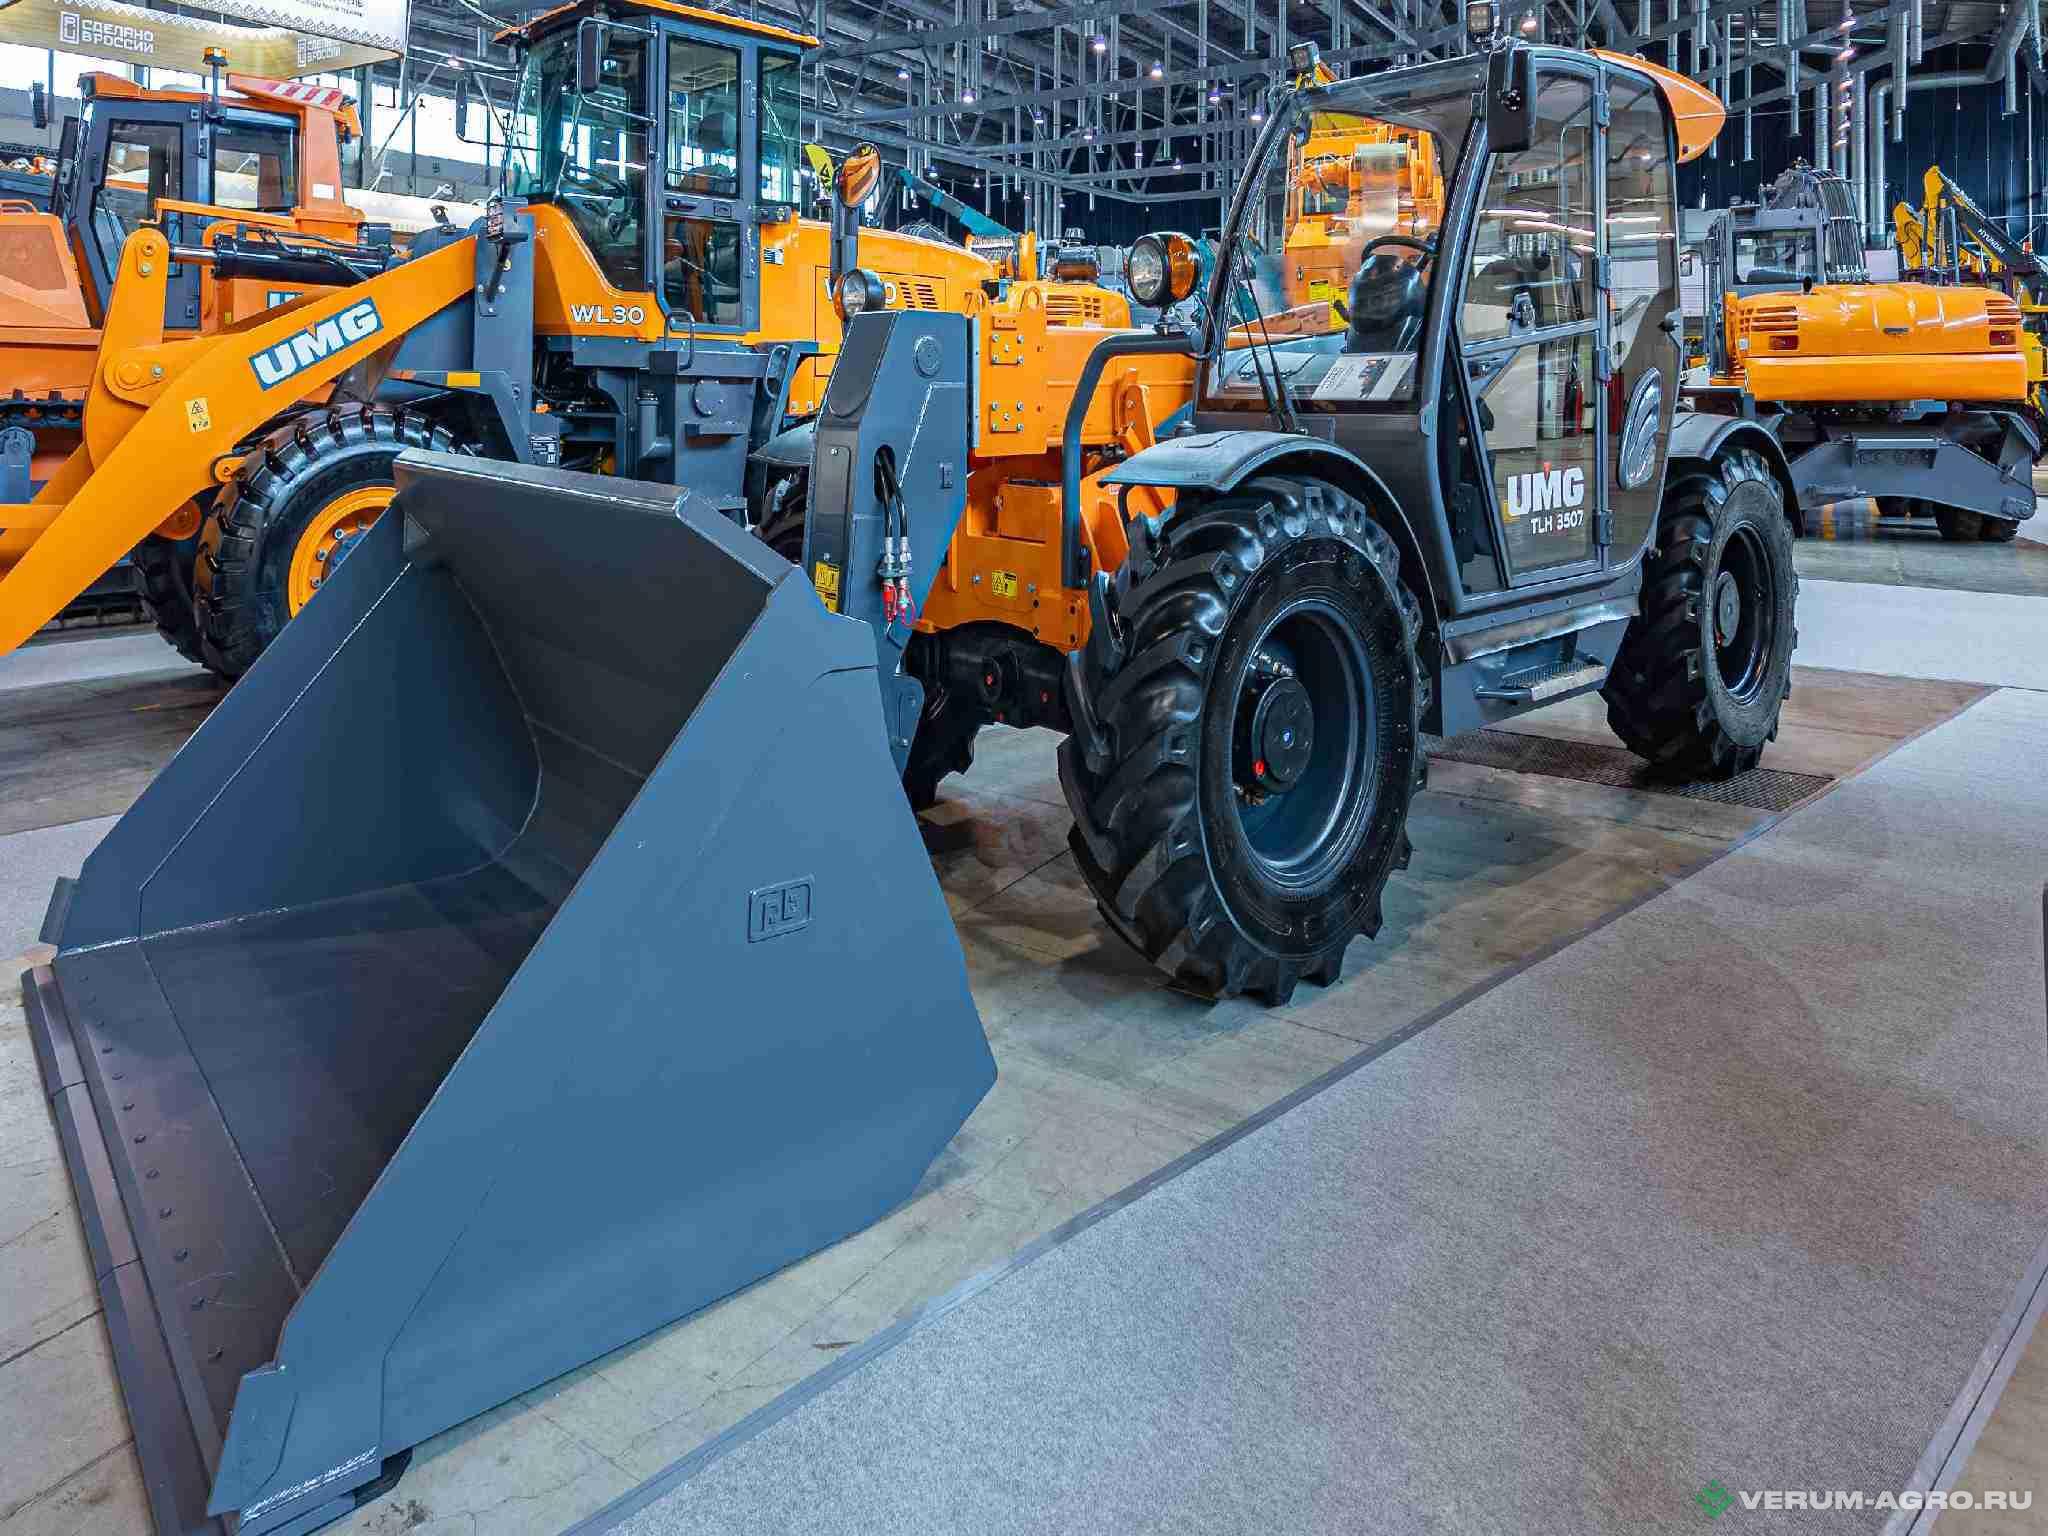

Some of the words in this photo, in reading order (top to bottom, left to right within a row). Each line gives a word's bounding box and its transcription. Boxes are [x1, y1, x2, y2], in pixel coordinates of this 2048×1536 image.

[81, 19, 154, 42] СДЕЛАНО
[569, 303, 645, 325] WL30
[253, 303, 379, 385] UMG
[1507, 467, 1585, 516] UMG
[1530, 515, 1553, 535] TLH
[1556, 509, 1585, 530] 3507
